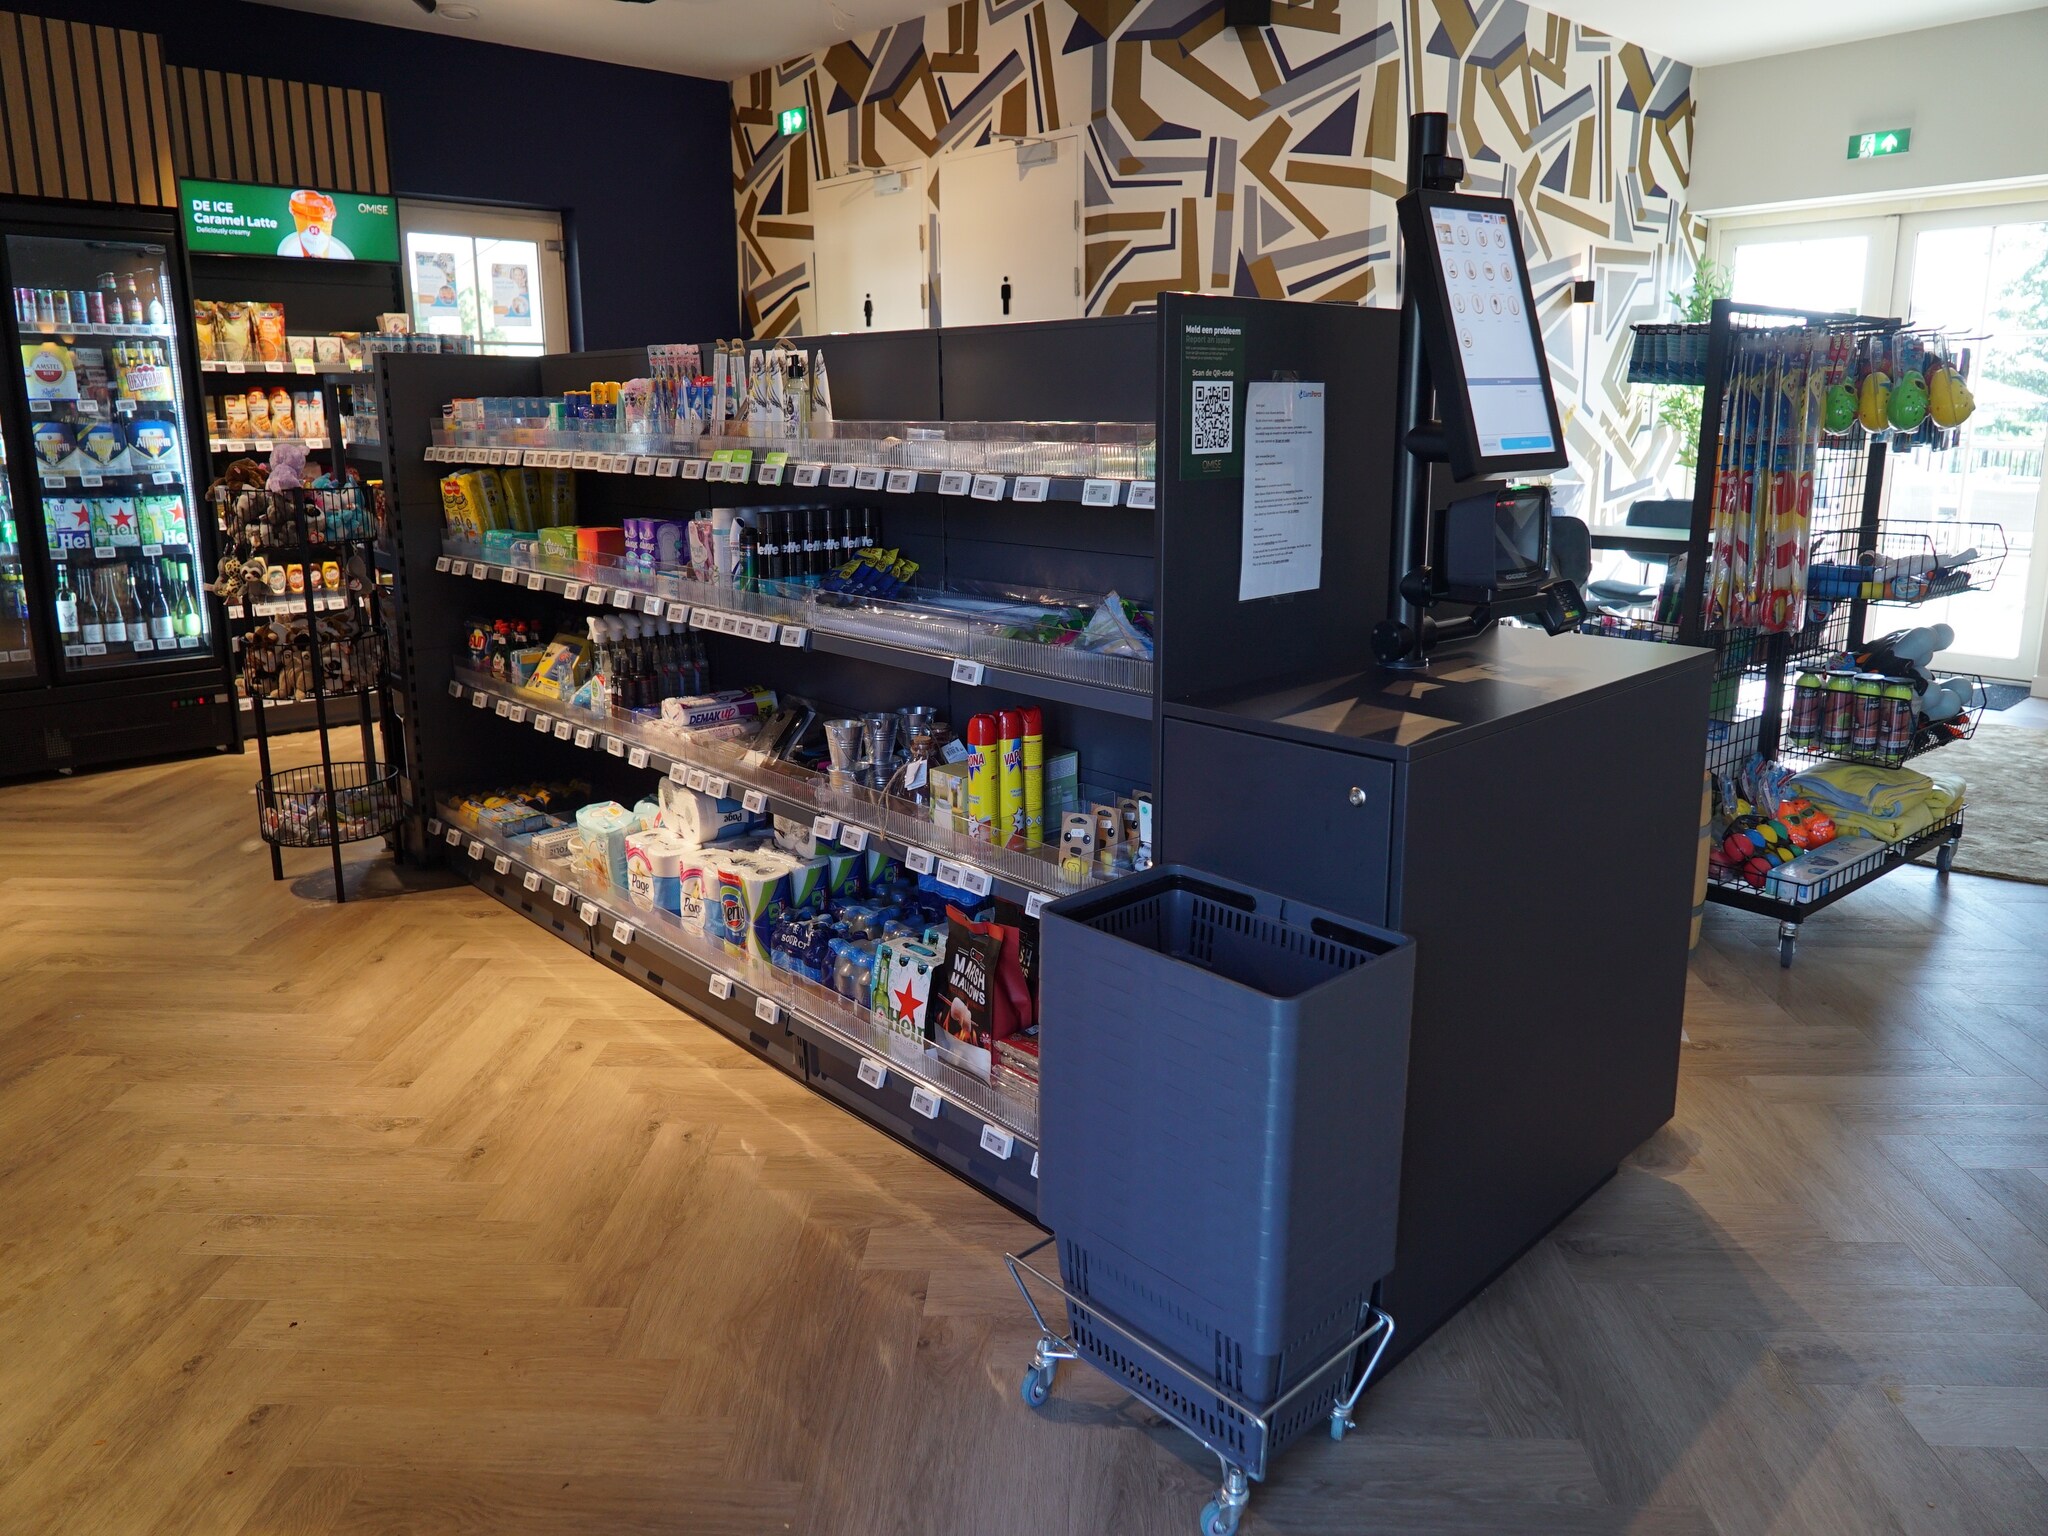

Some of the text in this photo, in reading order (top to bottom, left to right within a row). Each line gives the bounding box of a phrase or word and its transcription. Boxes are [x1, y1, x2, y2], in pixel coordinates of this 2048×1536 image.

[192, 199, 233, 213] DE ICE
[358, 203, 389, 215] OMISE
[193, 212, 278, 229] Caramel Latte
[196, 226, 228, 236] Deliciously
[1186, 325, 1200, 334] Meld
[1214, 326, 1241, 336] probleem
[1186, 335, 1206, 344] Report
[1216, 336, 1231, 344] issue
[1192, 369, 1234, 377] Scan de QR-code
[127, 371, 165, 391] DESPERADO
[1202, 460, 1222, 469] OMISE
[723, 812, 742, 823] Page
[631, 873, 649, 893] Page
[781, 933, 808, 950] SOURCY
[953, 953, 985, 991] MARSH
[950, 972, 986, 1006] MALLOWS
